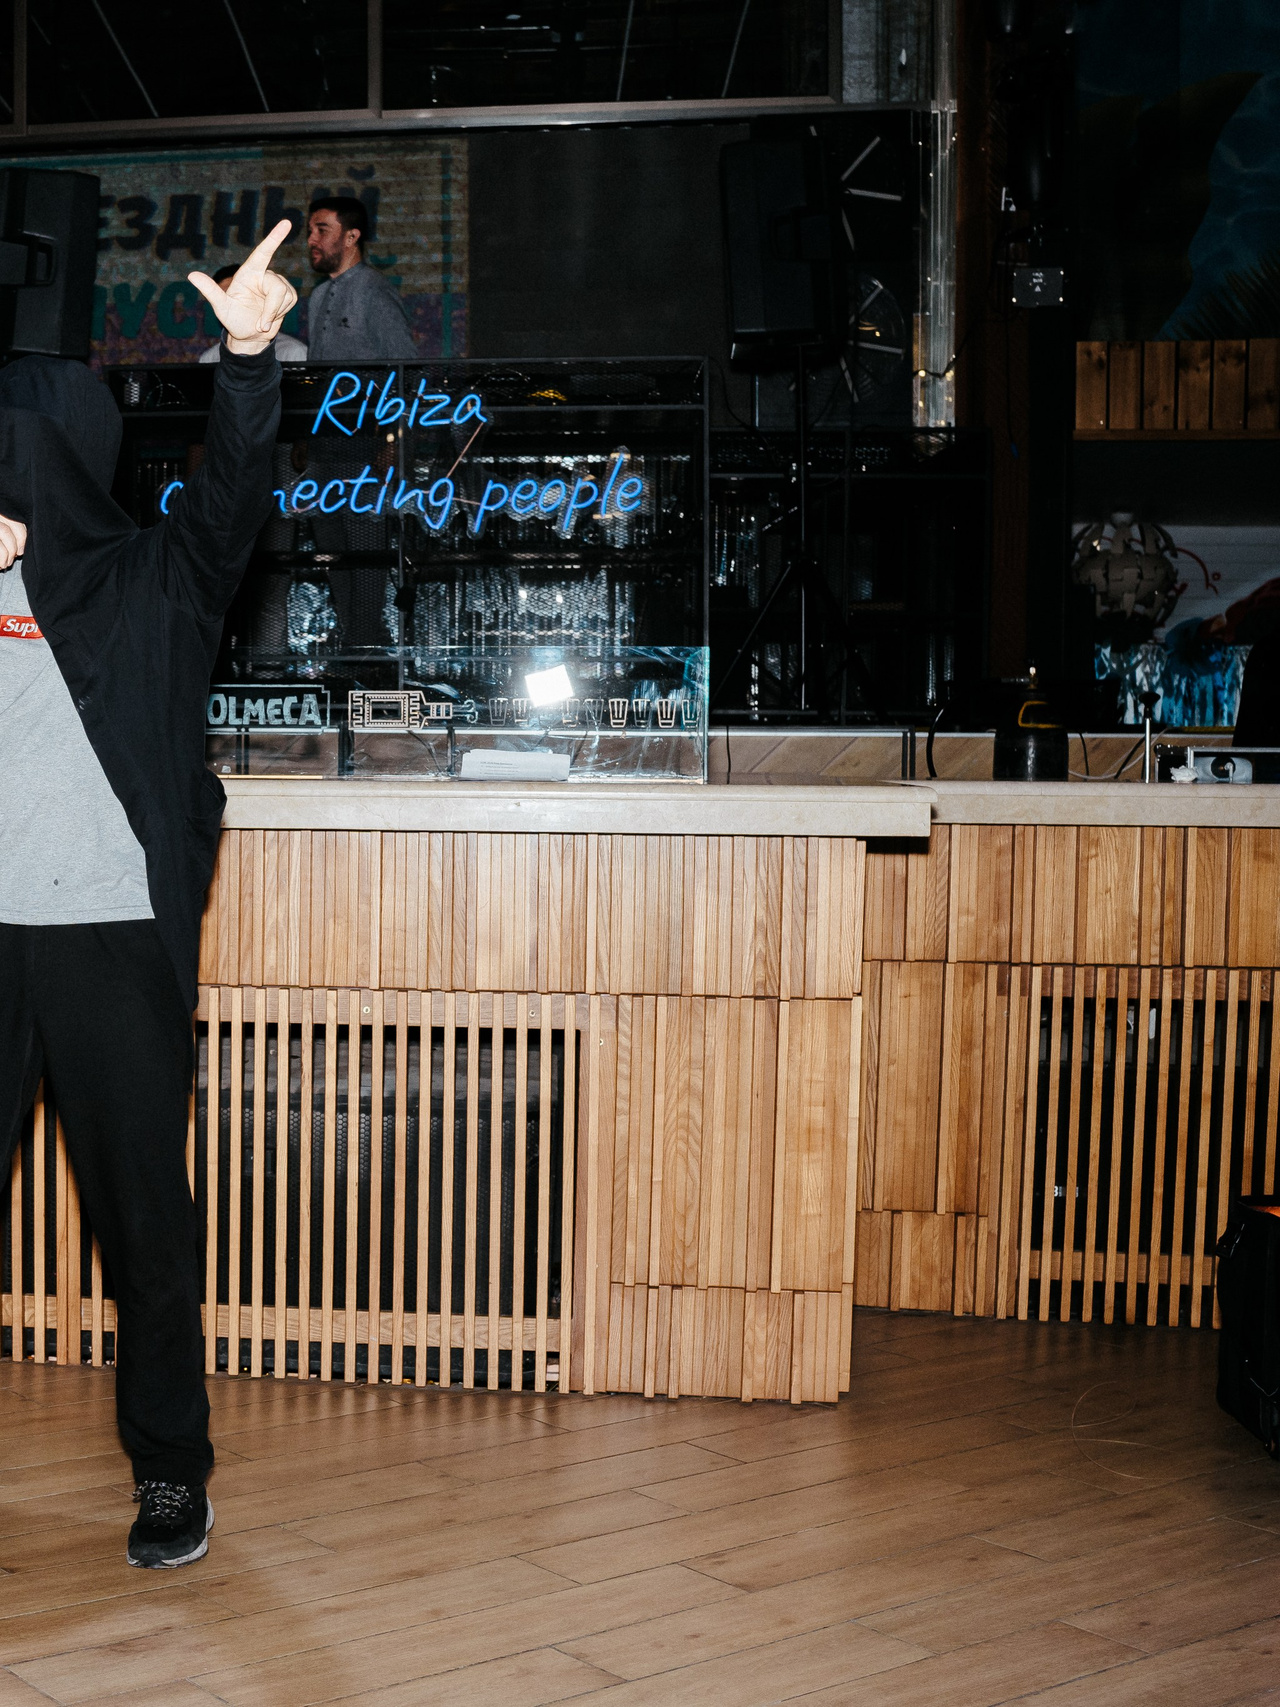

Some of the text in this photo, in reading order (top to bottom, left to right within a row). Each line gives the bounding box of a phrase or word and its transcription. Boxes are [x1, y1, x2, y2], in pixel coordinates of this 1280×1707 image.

[310, 370, 488, 437] Ribiza
[160, 454, 644, 534] cnecting people
[206, 693, 322, 725] OLMECA
